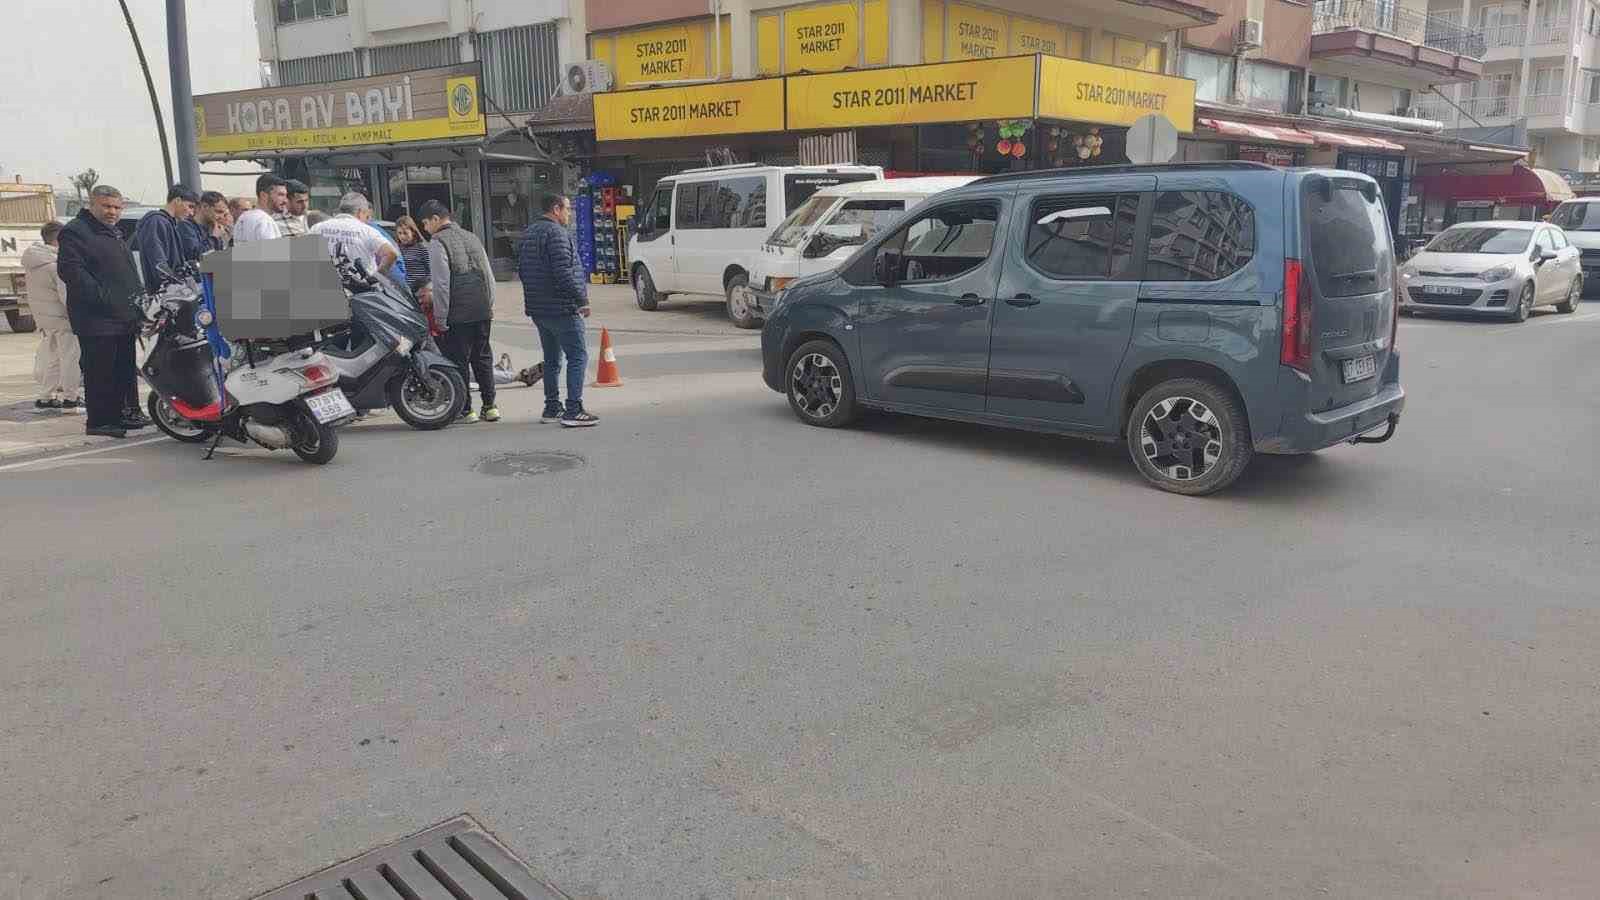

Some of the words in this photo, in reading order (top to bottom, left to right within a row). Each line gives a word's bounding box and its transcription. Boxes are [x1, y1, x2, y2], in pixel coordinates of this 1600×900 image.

[797, 25, 823, 41] STAR
[824, 22, 845, 38] 2011
[959, 22, 981, 39] STAR
[981, 27, 999, 42] 2011
[1020, 34, 1041, 49] STAR
[636, 41, 664, 58] STAR
[665, 38, 687, 55] 2011
[800, 37, 842, 55] MARKET
[960, 41, 996, 57] MARKET
[640, 58, 683, 76] MARKET
[832, 90, 871, 109] STAR
[874, 87, 905, 106] 2011
[909, 81, 978, 104] MARKET
[1075, 81, 1103, 102] STAR
[1104, 87, 1125, 105] 2011
[1126, 89, 1167, 111] MARKET
[226, 98, 292, 134] KOCA
[302, 94, 335, 129] AV
[630, 106, 661, 124] STAR
[662, 104, 687, 121] 2011
[688, 99, 741, 119] MARKET
